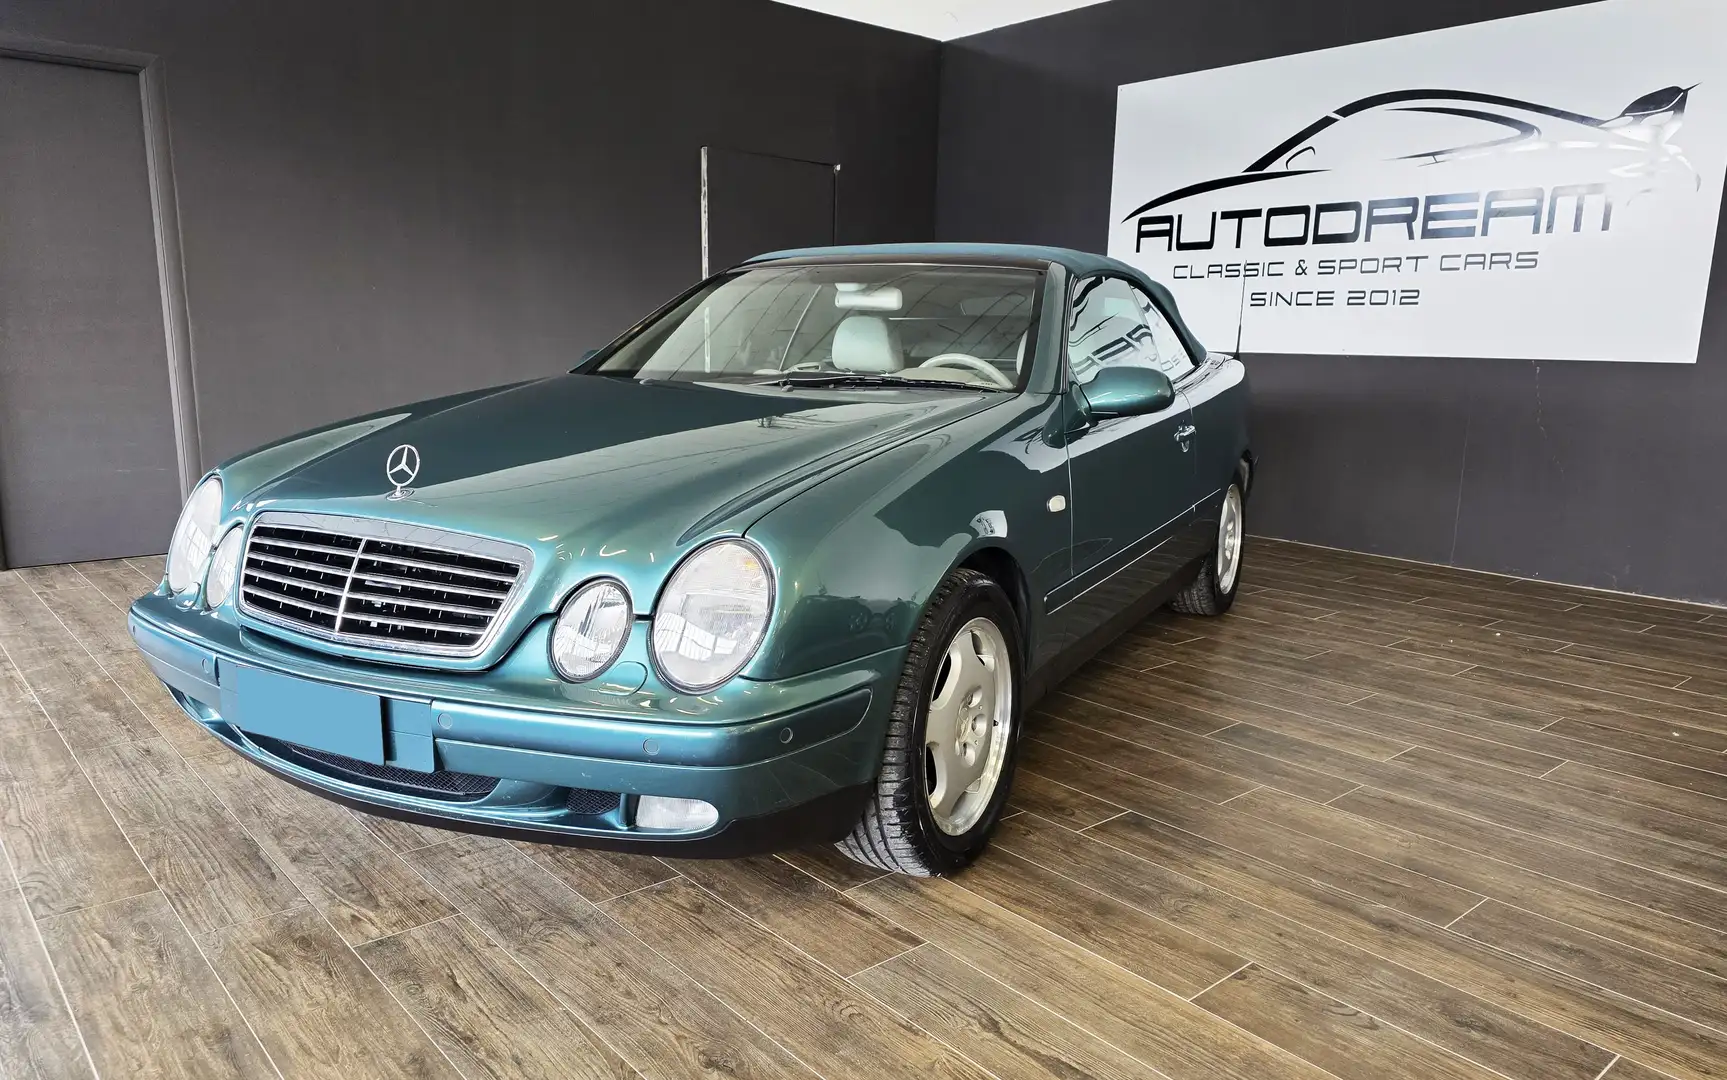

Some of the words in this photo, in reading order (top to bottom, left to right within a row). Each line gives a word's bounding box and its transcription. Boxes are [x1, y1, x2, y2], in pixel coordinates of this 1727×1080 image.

[1136, 183, 1613, 253] AUTODREAM
[1172, 261, 1285, 280] CLASSIC
[1294, 259, 1308, 276] &
[1317, 255, 1429, 275] SPORT
[1439, 251, 1539, 271] CARS
[1249, 291, 1335, 307] SINCE
[1347, 289, 1421, 306] 2012
